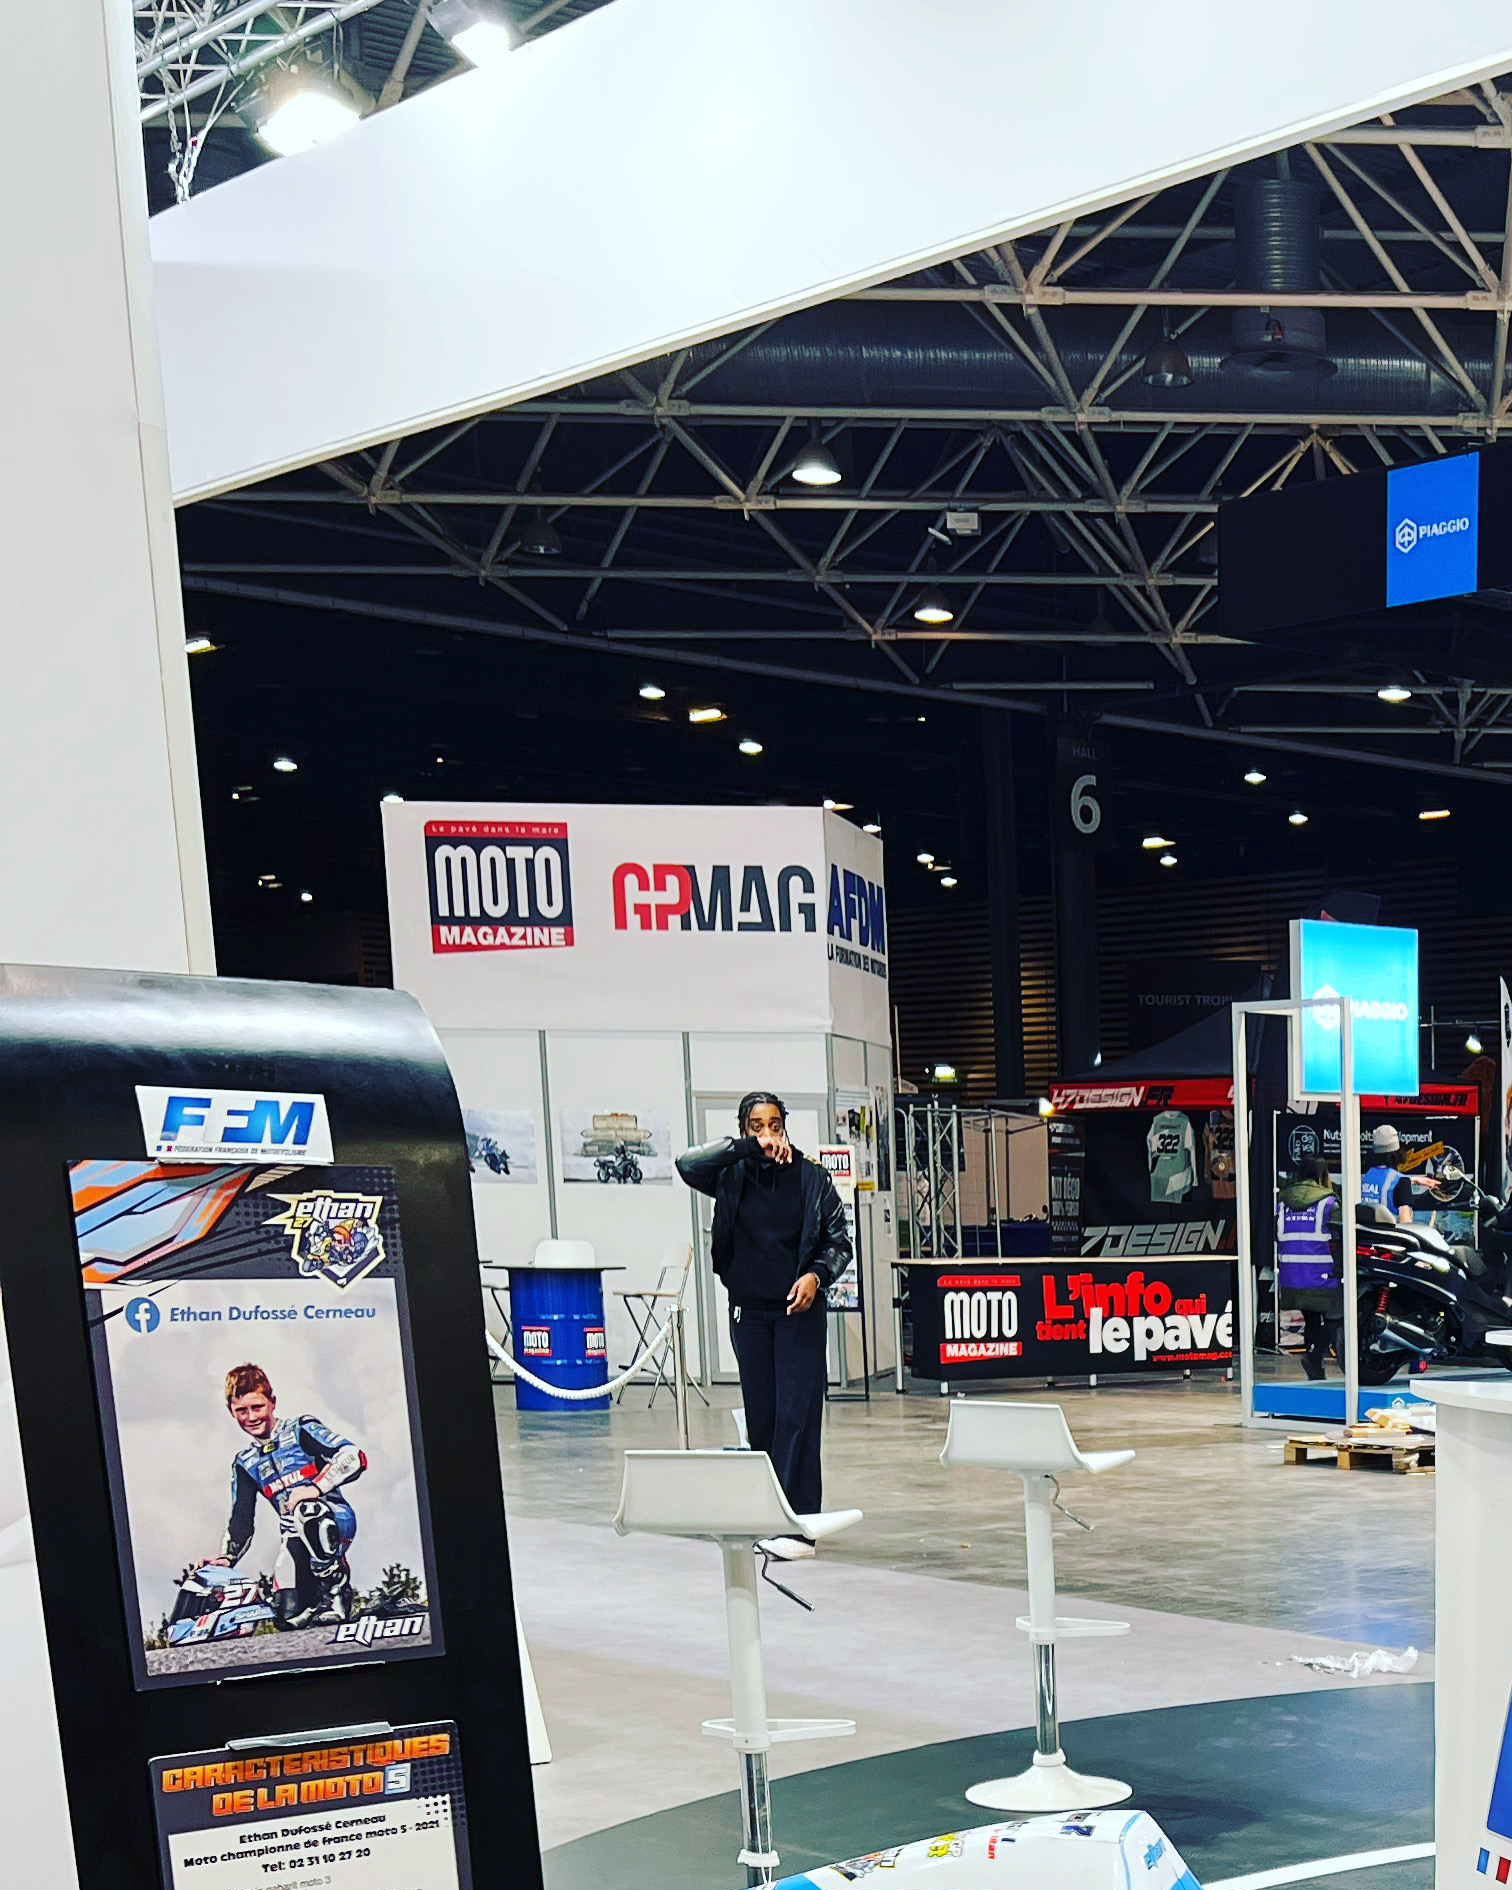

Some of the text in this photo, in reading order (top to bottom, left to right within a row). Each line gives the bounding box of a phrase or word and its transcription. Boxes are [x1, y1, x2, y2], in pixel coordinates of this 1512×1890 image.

[1418, 517, 1469, 539] PIAGGIO
[1070, 774, 1101, 834] 6
[434, 844, 564, 919] MOTO
[827, 863, 886, 956] AFDM
[440, 925, 566, 946] MAGAZINE
[159, 1095, 316, 1146] FFM
[821, 1152, 850, 1170] MOTO
[295, 1195, 375, 1222] ethan
[1042, 1270, 1207, 1320] L'info qui
[170, 1306, 222, 1323] Ethan
[228, 1304, 298, 1321] Dufossé
[303, 1304, 376, 1320] Cerneau
[944, 1290, 1019, 1340] MOTO
[523, 1330, 549, 1349] MOTO
[1035, 1319, 1087, 1341] tient
[945, 1342, 1018, 1358] MAGAZINE
[224, 1584, 257, 1608] 27
[336, 1614, 426, 1648] ethan
[161, 1733, 450, 1793] CARACTERISTIQUES
[212, 1789, 255, 1817] DE
[256, 1782, 298, 1810] LA
[299, 1770, 385, 1805] MOTO
[183, 1855, 218, 1868] Moto
[220, 1842, 301, 1862] championne
[303, 1839, 320, 1849] de
[365, 1827, 398, 1839] moto
[400, 1824, 407, 1834] 5
[414, 1819, 440, 1832] 2021
[239, 1814, 386, 1845] Ethan Dufossé Cerneau
[261, 1847, 371, 1873] Tel: 02 31 10 27 20
